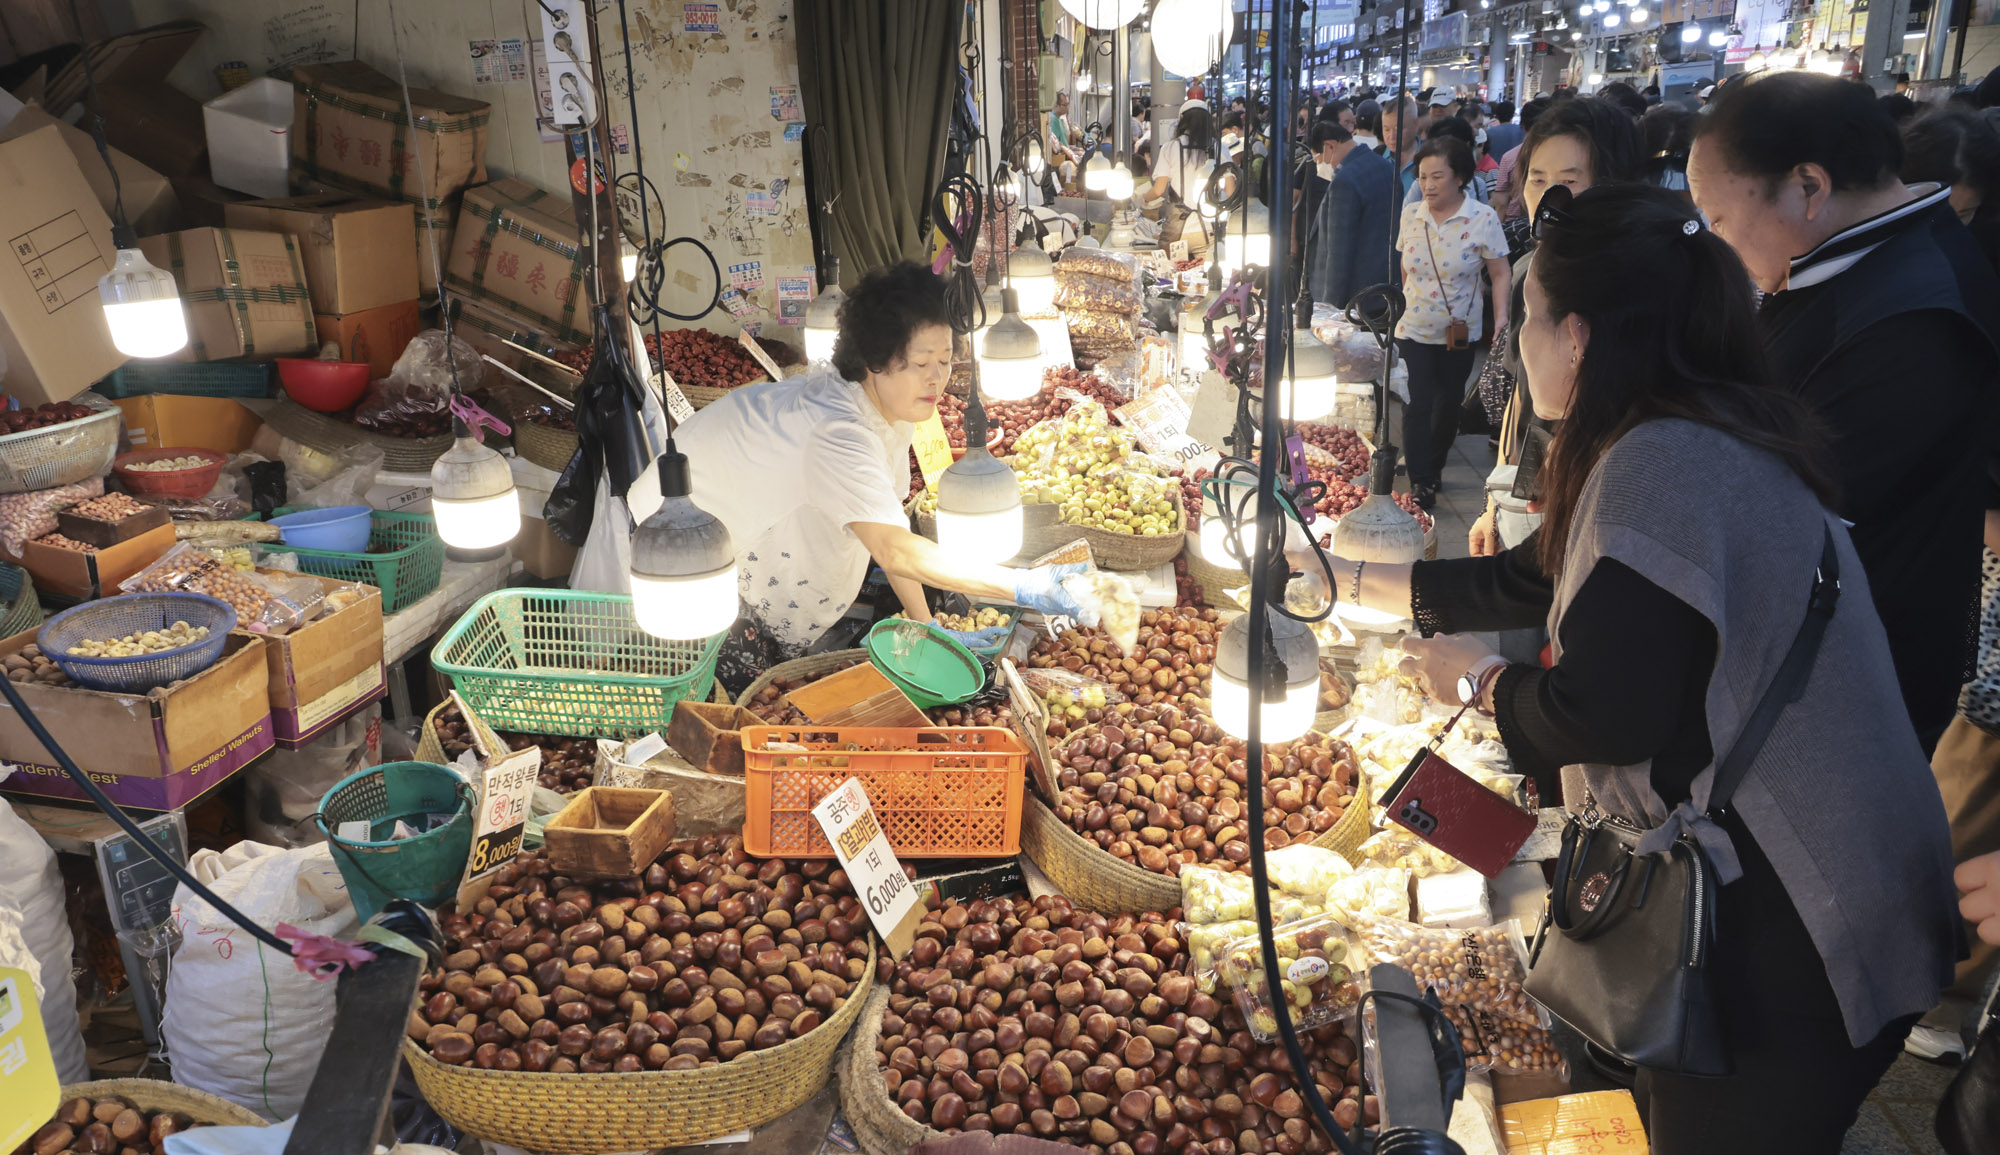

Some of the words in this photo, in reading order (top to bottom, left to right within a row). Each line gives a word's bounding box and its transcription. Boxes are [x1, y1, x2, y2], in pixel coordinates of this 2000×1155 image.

[190, 748, 226, 775] Shelled
[228, 725, 263, 751] Walnuts
[10, 760, 71, 779] nden's
[87, 772, 119, 785] est
[509, 797, 525, 816] 1되
[827, 796, 850, 824] 공주
[472, 835, 522, 872] 8,000원
[865, 848, 882, 872] 1되
[866, 870, 908, 916] 6,000원
